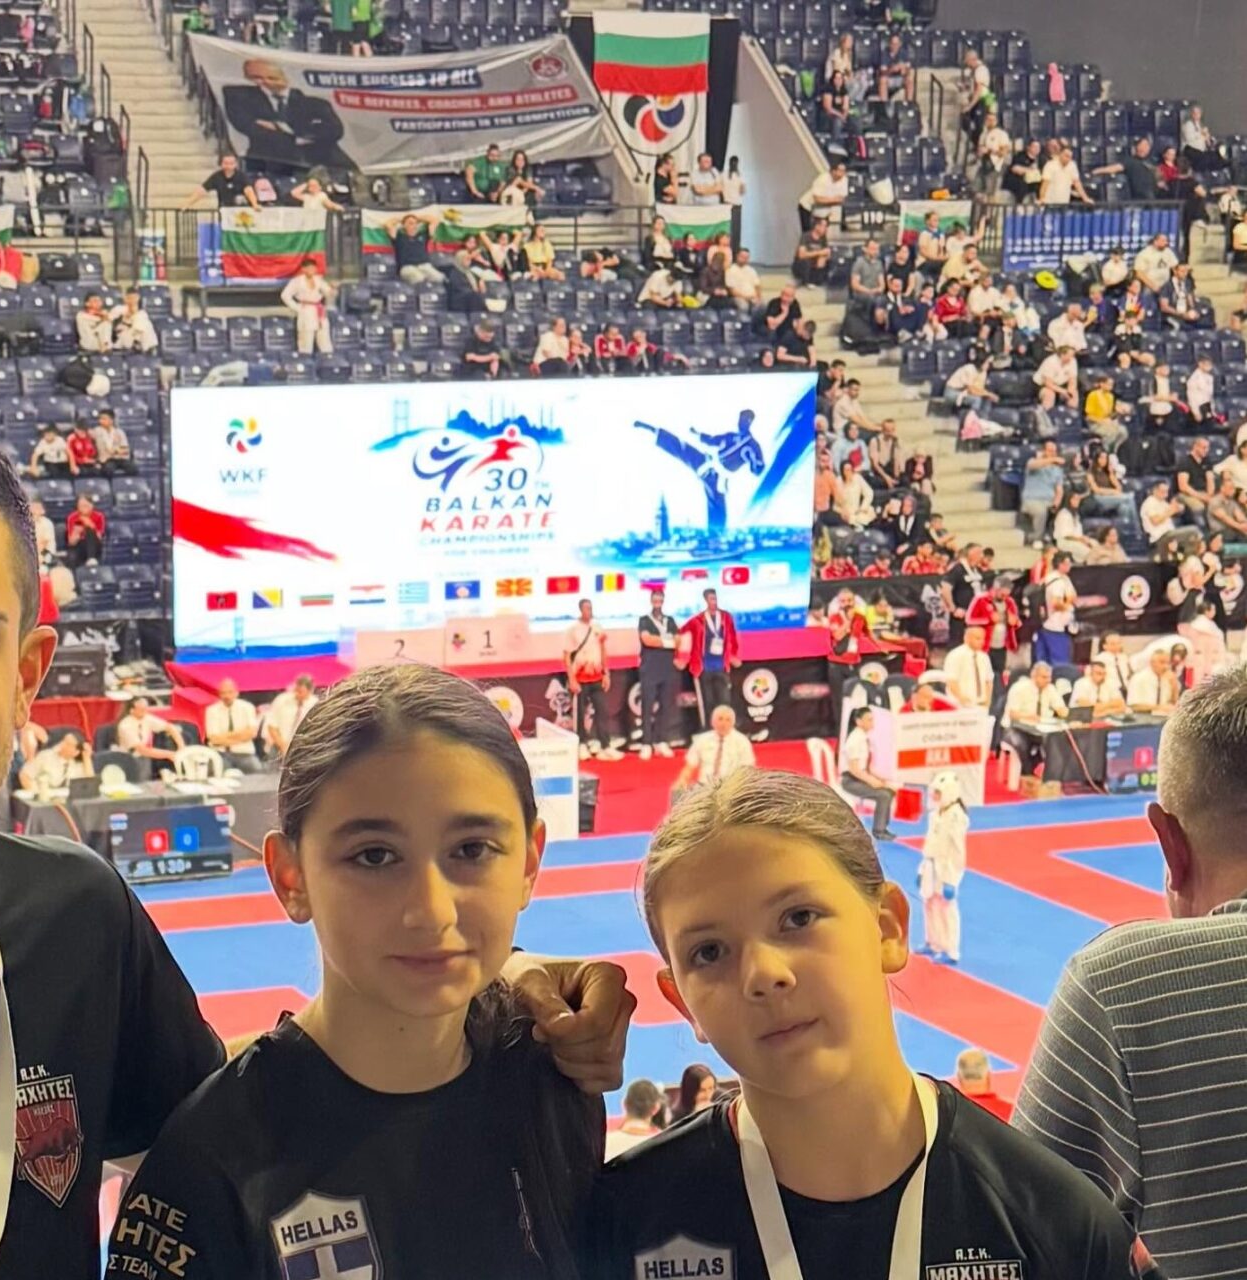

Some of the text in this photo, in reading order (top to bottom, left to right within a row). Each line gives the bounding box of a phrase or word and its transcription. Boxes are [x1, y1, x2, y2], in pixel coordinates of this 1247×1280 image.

[219, 468, 269, 484] WKF
[484, 467, 528, 492] 30
[425, 493, 553, 513] BALKAN
[420, 510, 557, 533] KARATE
[419, 531, 556, 545] CHAMPIONSHIPS
[394, 639, 406, 658] 2
[483, 629, 493, 649] 1
[280, 1210, 359, 1247] HELLAS
[643, 1257, 725, 1280] HELLAS
